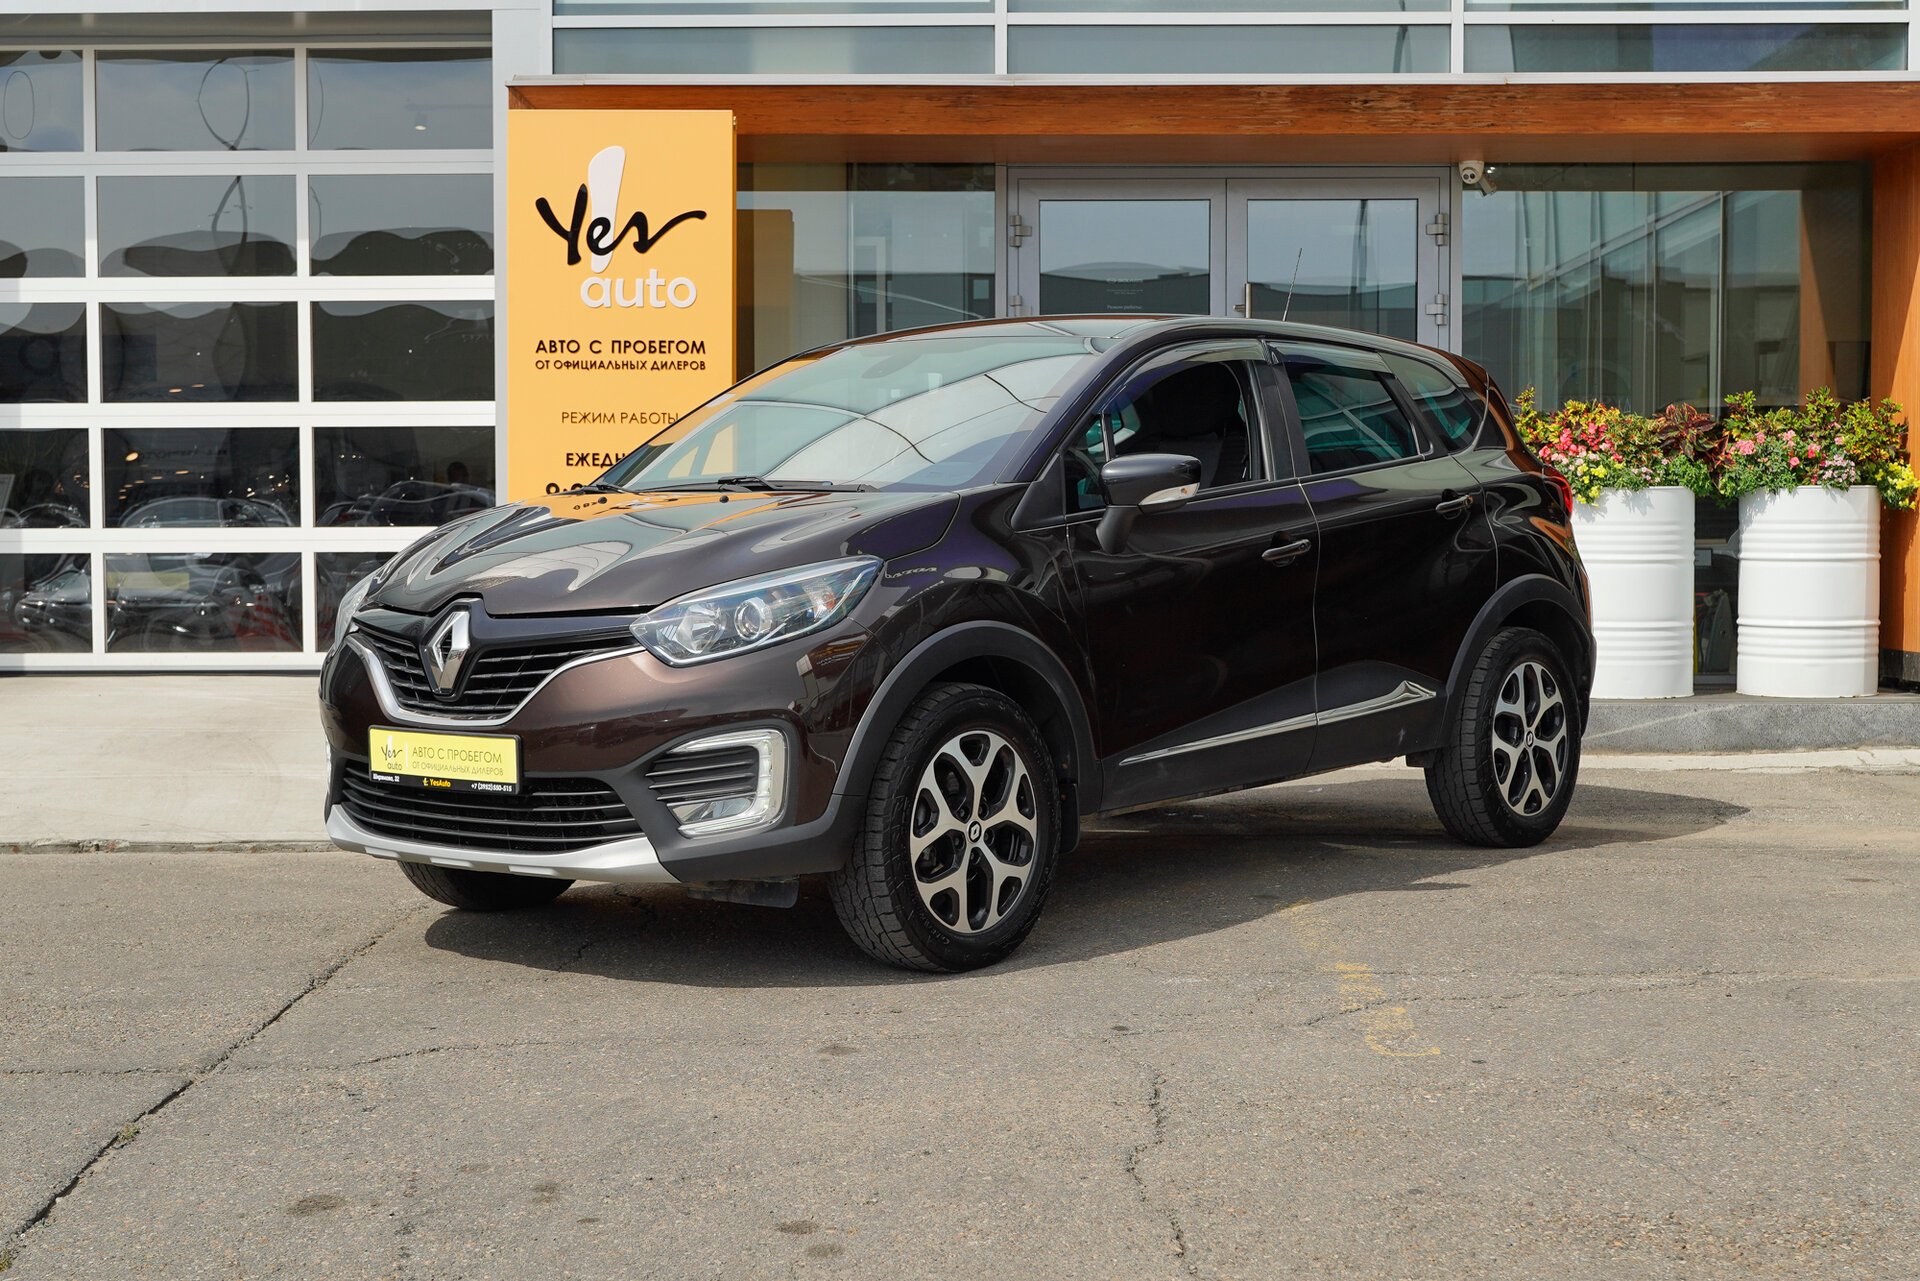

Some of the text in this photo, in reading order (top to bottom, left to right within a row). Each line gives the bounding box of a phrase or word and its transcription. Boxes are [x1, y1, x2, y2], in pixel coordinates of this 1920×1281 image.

[535, 183, 707, 265] Yes
[580, 268, 698, 308] auto
[535, 339, 706, 354] АВТО С ПРОБЕГОМ
[535, 360, 706, 371] ОТ ОФИЦИАЛЬНЫХ ДИЛЕРОВ
[561, 411, 679, 424] РЕЖИМ РАБОТЫ
[412, 746, 502, 763] АВТО С ПРОБЕГОМ
[387, 762, 403, 771] auto
[412, 761, 504, 776] ОТ ОФИЦИАЛЬНЫХ ДИЛЕРОВ
[430, 778, 451, 787] YesAuto
